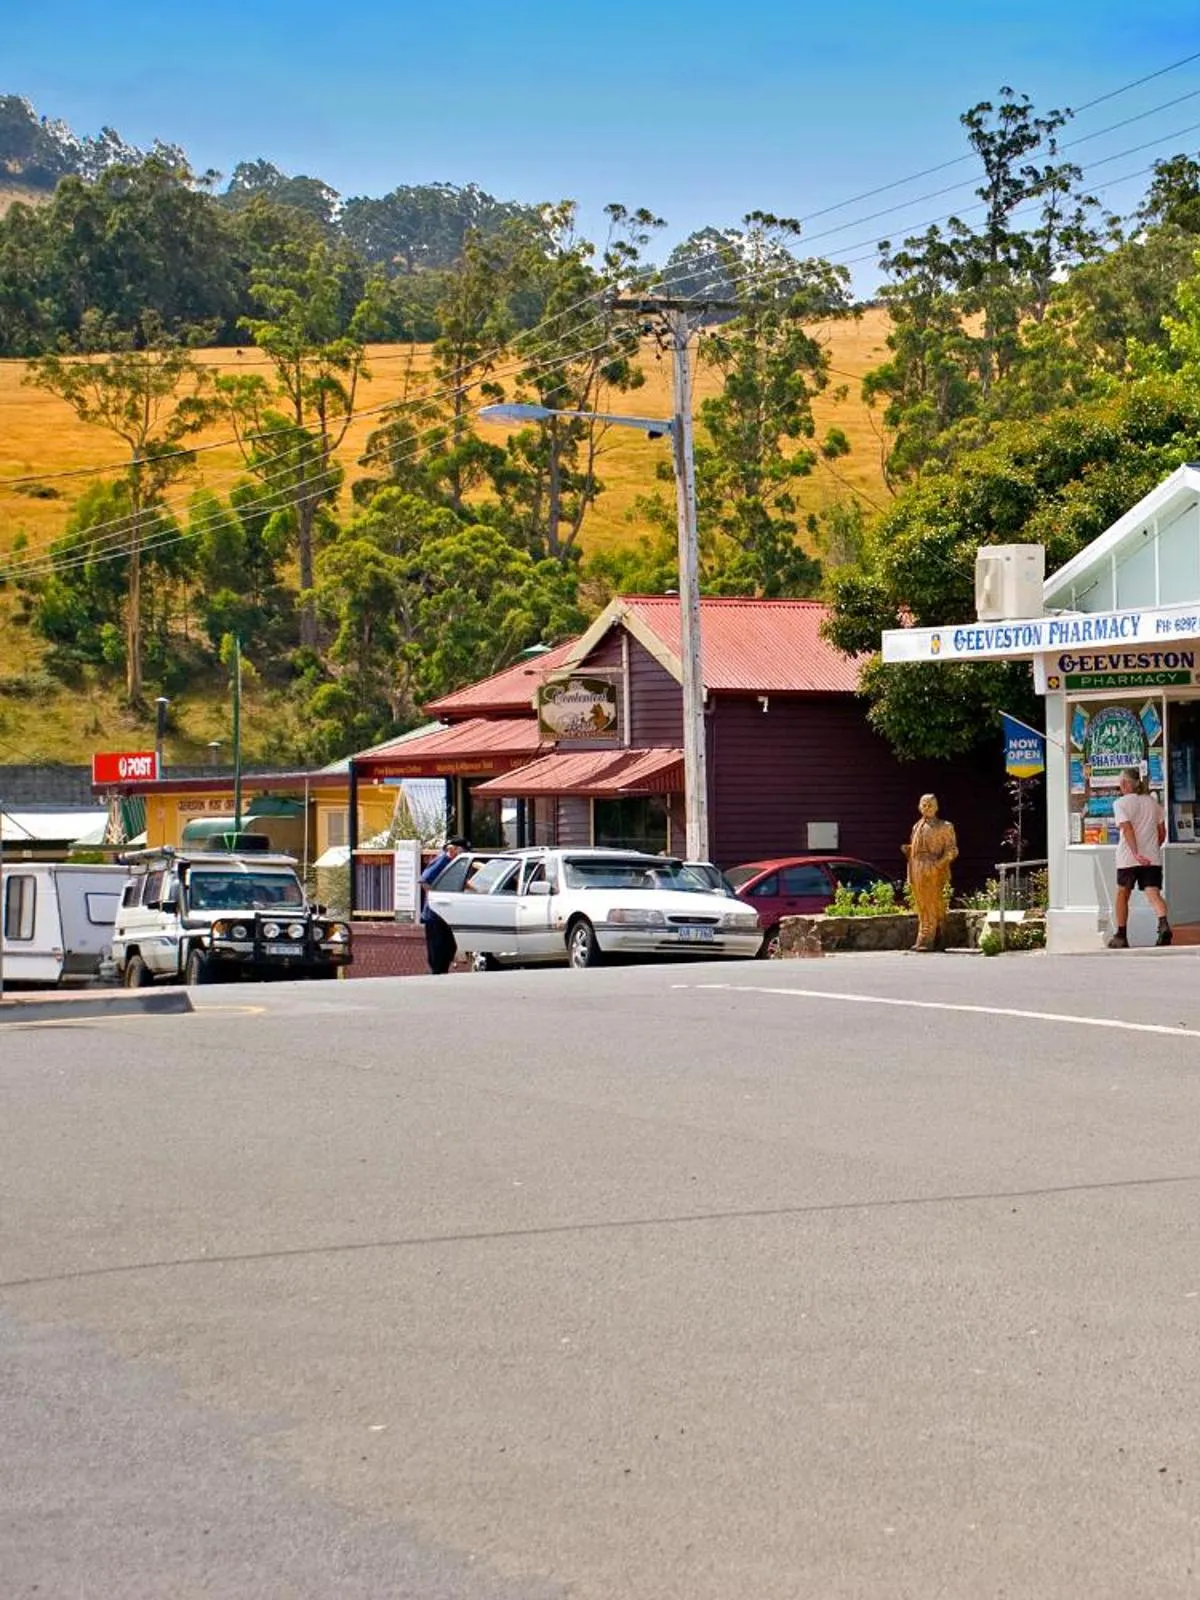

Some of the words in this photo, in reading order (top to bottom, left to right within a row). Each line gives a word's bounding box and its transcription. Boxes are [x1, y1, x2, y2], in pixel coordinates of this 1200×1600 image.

[954, 626, 1043, 652] GEEVESTON
[1049, 613, 1142, 645] PHARMACY
[1058, 651, 1195, 673] GEEVESTON
[1081, 673, 1178, 687] PHARMACY
[1009, 738, 1038, 749] NOW
[1007, 749, 1041, 761] OPEN
[127, 757, 152, 776] POST
